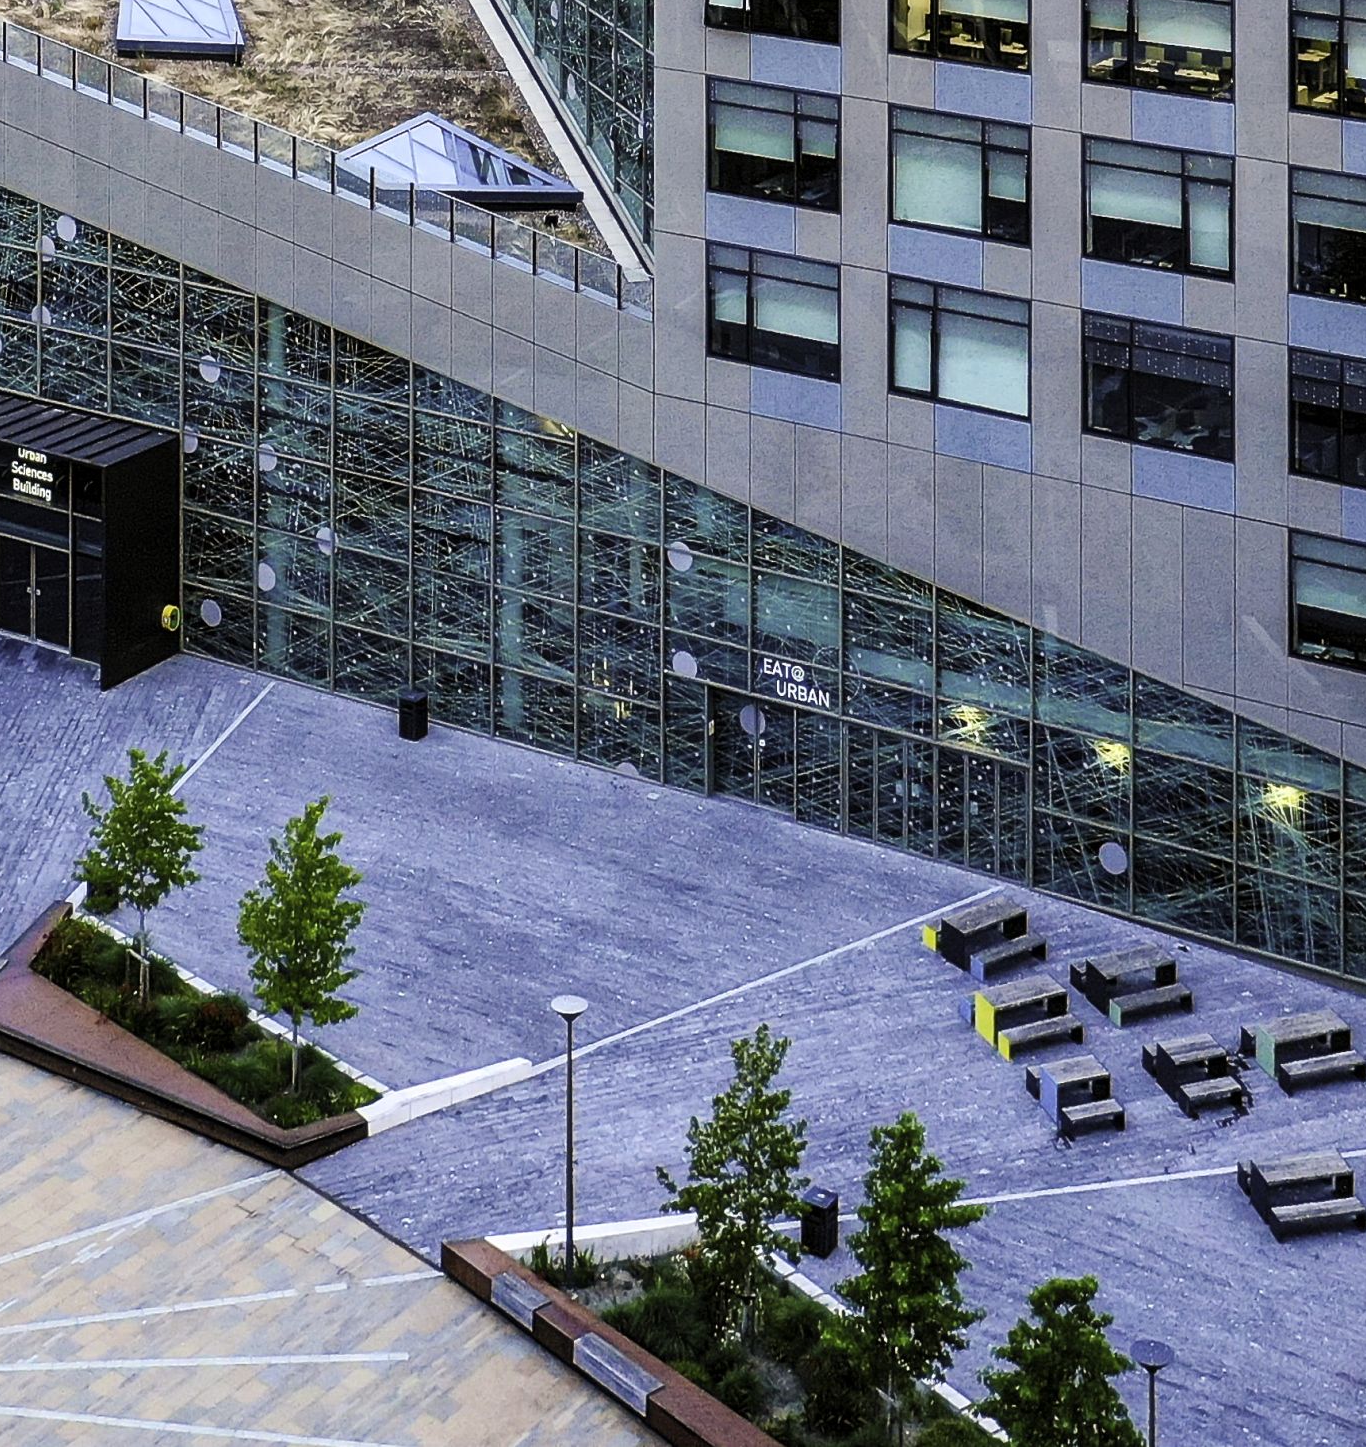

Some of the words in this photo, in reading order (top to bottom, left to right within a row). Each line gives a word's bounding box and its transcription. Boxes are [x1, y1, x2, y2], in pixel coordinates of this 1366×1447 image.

[17, 447, 47, 465] Urban
[11, 460, 54, 482] Sciences
[12, 477, 52, 502] Building
[763, 657, 805, 683] EAT@
[776, 678, 831, 709] URBAN
